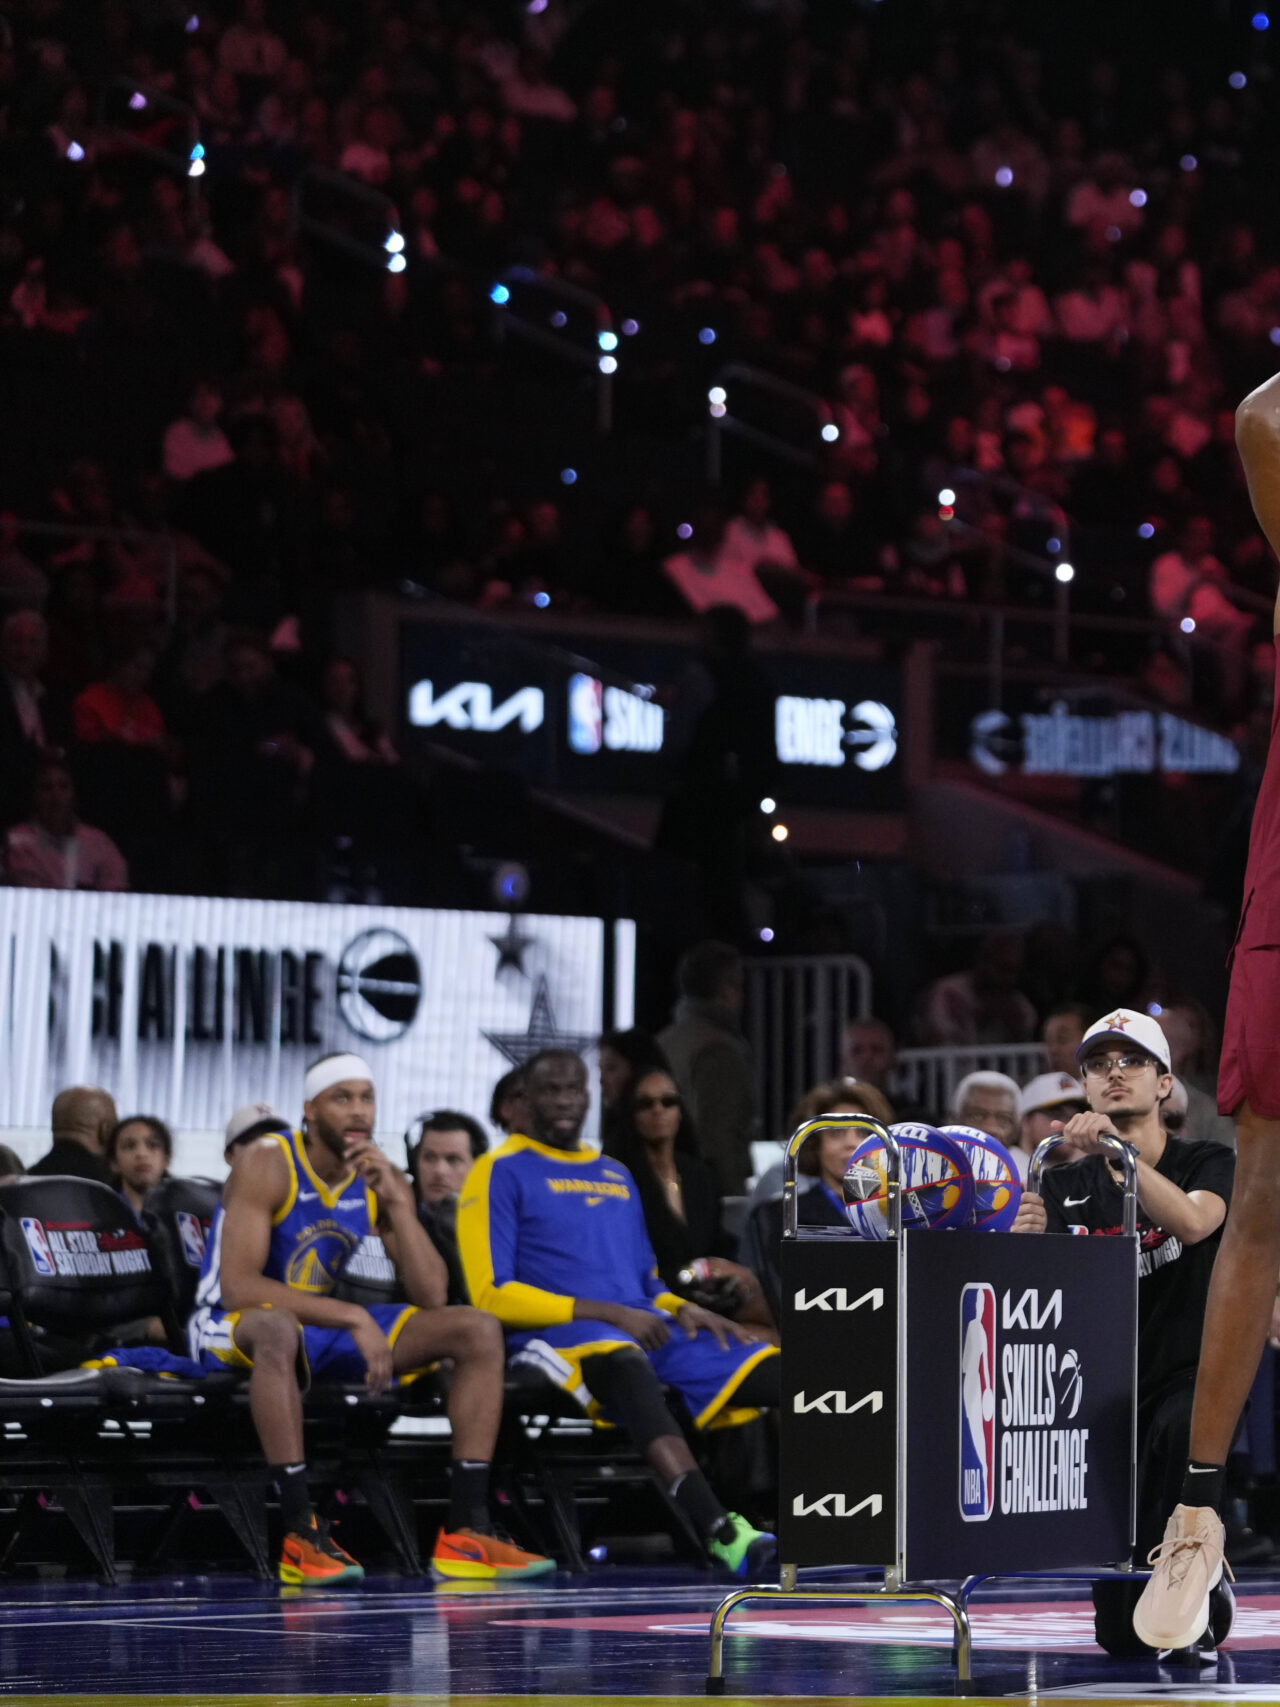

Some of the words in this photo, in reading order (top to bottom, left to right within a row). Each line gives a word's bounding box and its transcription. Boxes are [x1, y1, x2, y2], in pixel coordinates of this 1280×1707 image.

[409, 679, 544, 733] KIA
[795, 1287, 884, 1311] KIA
[1003, 1288, 1063, 1330] KIA
[794, 1390, 884, 1414] KIA
[1001, 1343, 1056, 1427] SKILLS
[964, 1468, 981, 1505] NBA
[1001, 1428, 1088, 1515] CHALLENGE
[793, 1493, 883, 1517] KIA
